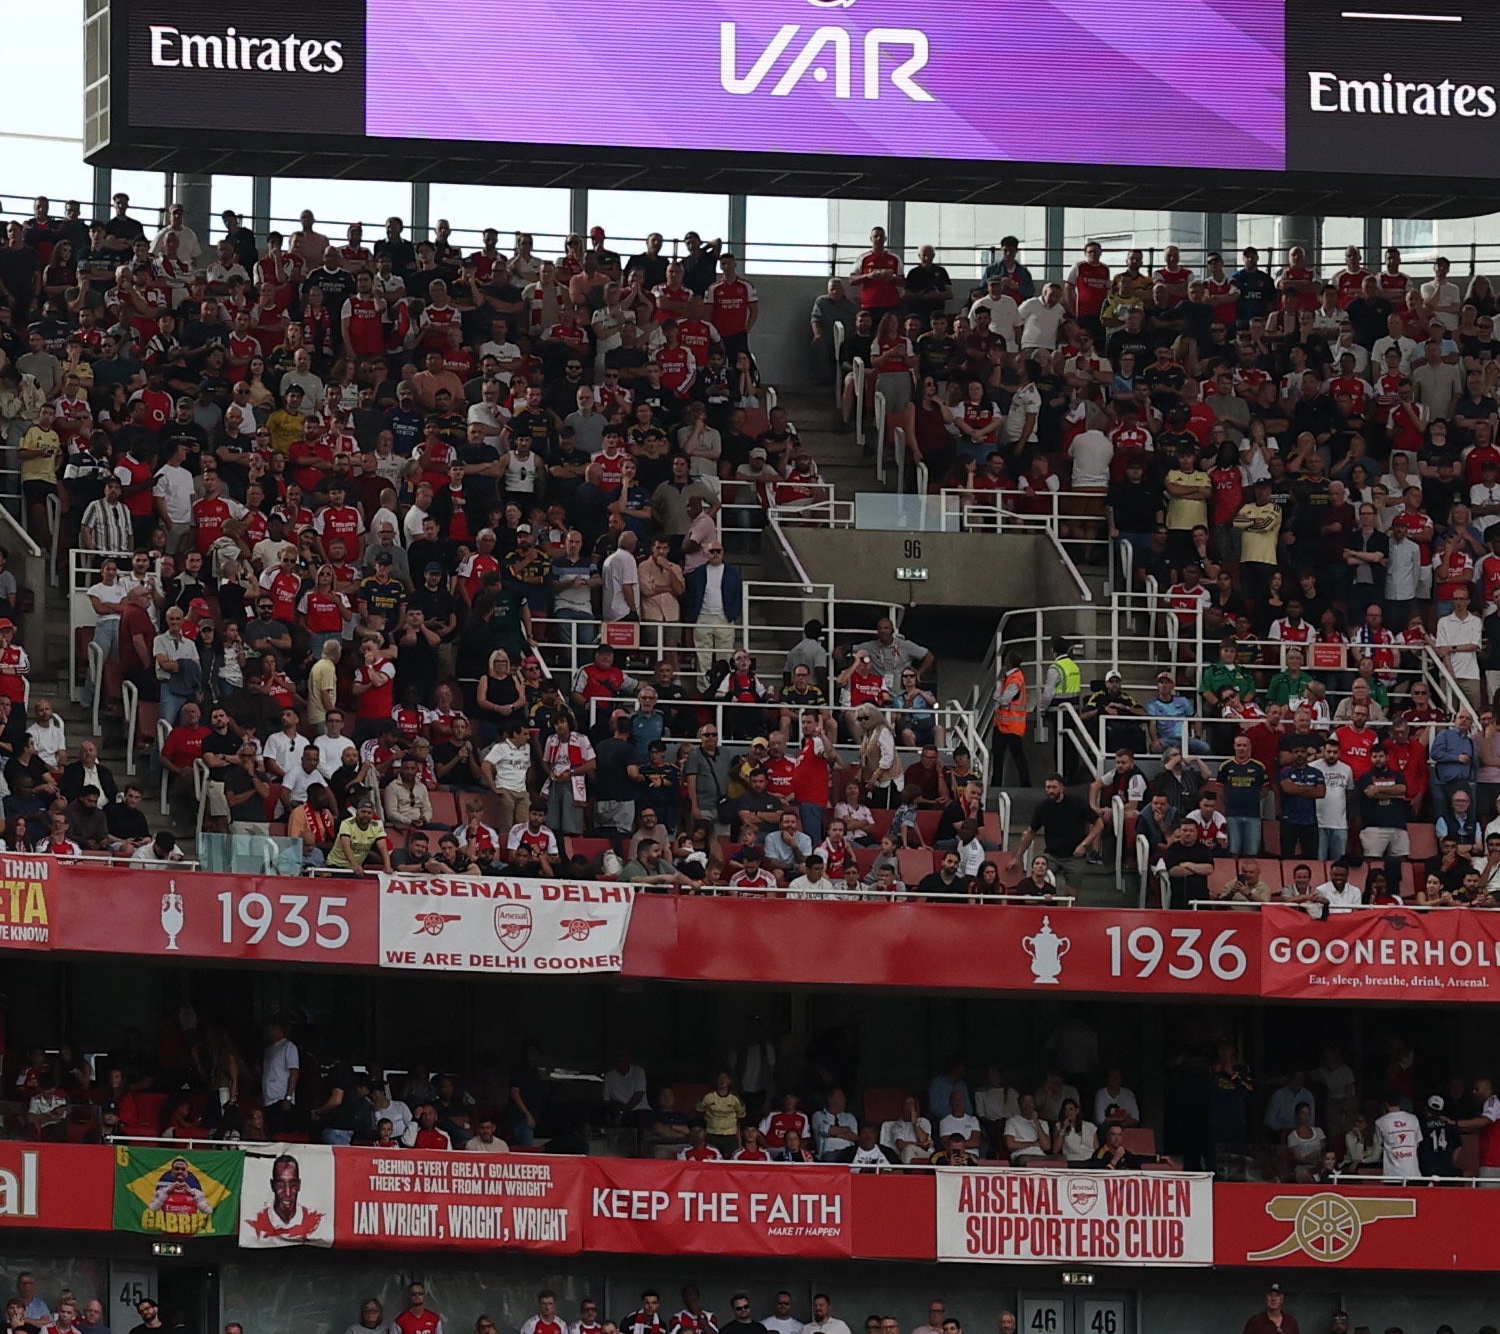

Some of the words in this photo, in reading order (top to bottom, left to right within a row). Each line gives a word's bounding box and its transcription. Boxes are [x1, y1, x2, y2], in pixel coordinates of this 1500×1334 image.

[150, 25, 344, 76] Emirates
[721, 21, 936, 104] VAR
[1309, 69, 1498, 120] Emirates
[904, 539, 922, 559] 96
[1347, 747, 1367, 756] JVC
[4, 858, 48, 880] THAN
[387, 878, 532, 900] ARSENAL
[541, 884, 631, 903] DELHI
[219, 890, 350, 950] 1935
[499, 911, 528, 920] Arsenal
[10, 927, 49, 943] KNOW!
[386, 951, 416, 965] WE
[423, 952, 462, 966] ARE
[469, 954, 526, 969] DELHI
[533, 955, 623, 969] GOONER
[1105, 925, 1247, 981] 1936
[1309, 974, 1329, 987] Eat,
[1332, 974, 1362, 988] sleep,
[1365, 974, 1409, 988] breathe,
[1411, 975, 1444, 989] drink,
[1447, 976, 1490, 988] Arsenal.
[372, 1159, 415, 1176] "BEHIND
[417, 1160, 449, 1177] EVERY
[451, 1162, 485, 1179] GREAT
[487, 1163, 551, 1181] GOALKEEPER
[369, 1175, 411, 1192] THERE'S
[413, 1177, 421, 1192] A
[424, 1178, 450, 1194] BALL
[452, 1179, 482, 1196] FROM
[484, 1180, 502, 1197] IAN
[503, 1180, 554, 1198] WRIGHT"
[958, 1175, 1063, 1216] ARSENAL
[1105, 1179, 1191, 1218] WOMEN
[592, 1186, 670, 1222] KEEP
[678, 1189, 739, 1224] THE
[749, 1191, 842, 1225] FAITH
[141, 1209, 217, 1234] GABRIEL
[354, 1201, 380, 1234] IAN
[382, 1203, 444, 1239] WRIGHT,
[448, 1205, 509, 1241] WRIGHT,
[512, 1207, 568, 1242] WRIGHT
[768, 1226, 794, 1237] MAKE
[795, 1226, 804, 1237] IT
[805, 1227, 841, 1238] HAPPEN
[966, 1216, 1121, 1258] SUPPORTERS
[1125, 1219, 1185, 1259] CLUB
[120, 1281, 143, 1307] 45
[1031, 1308, 1057, 1334] 46
[1090, 1309, 1117, 1334] 46
